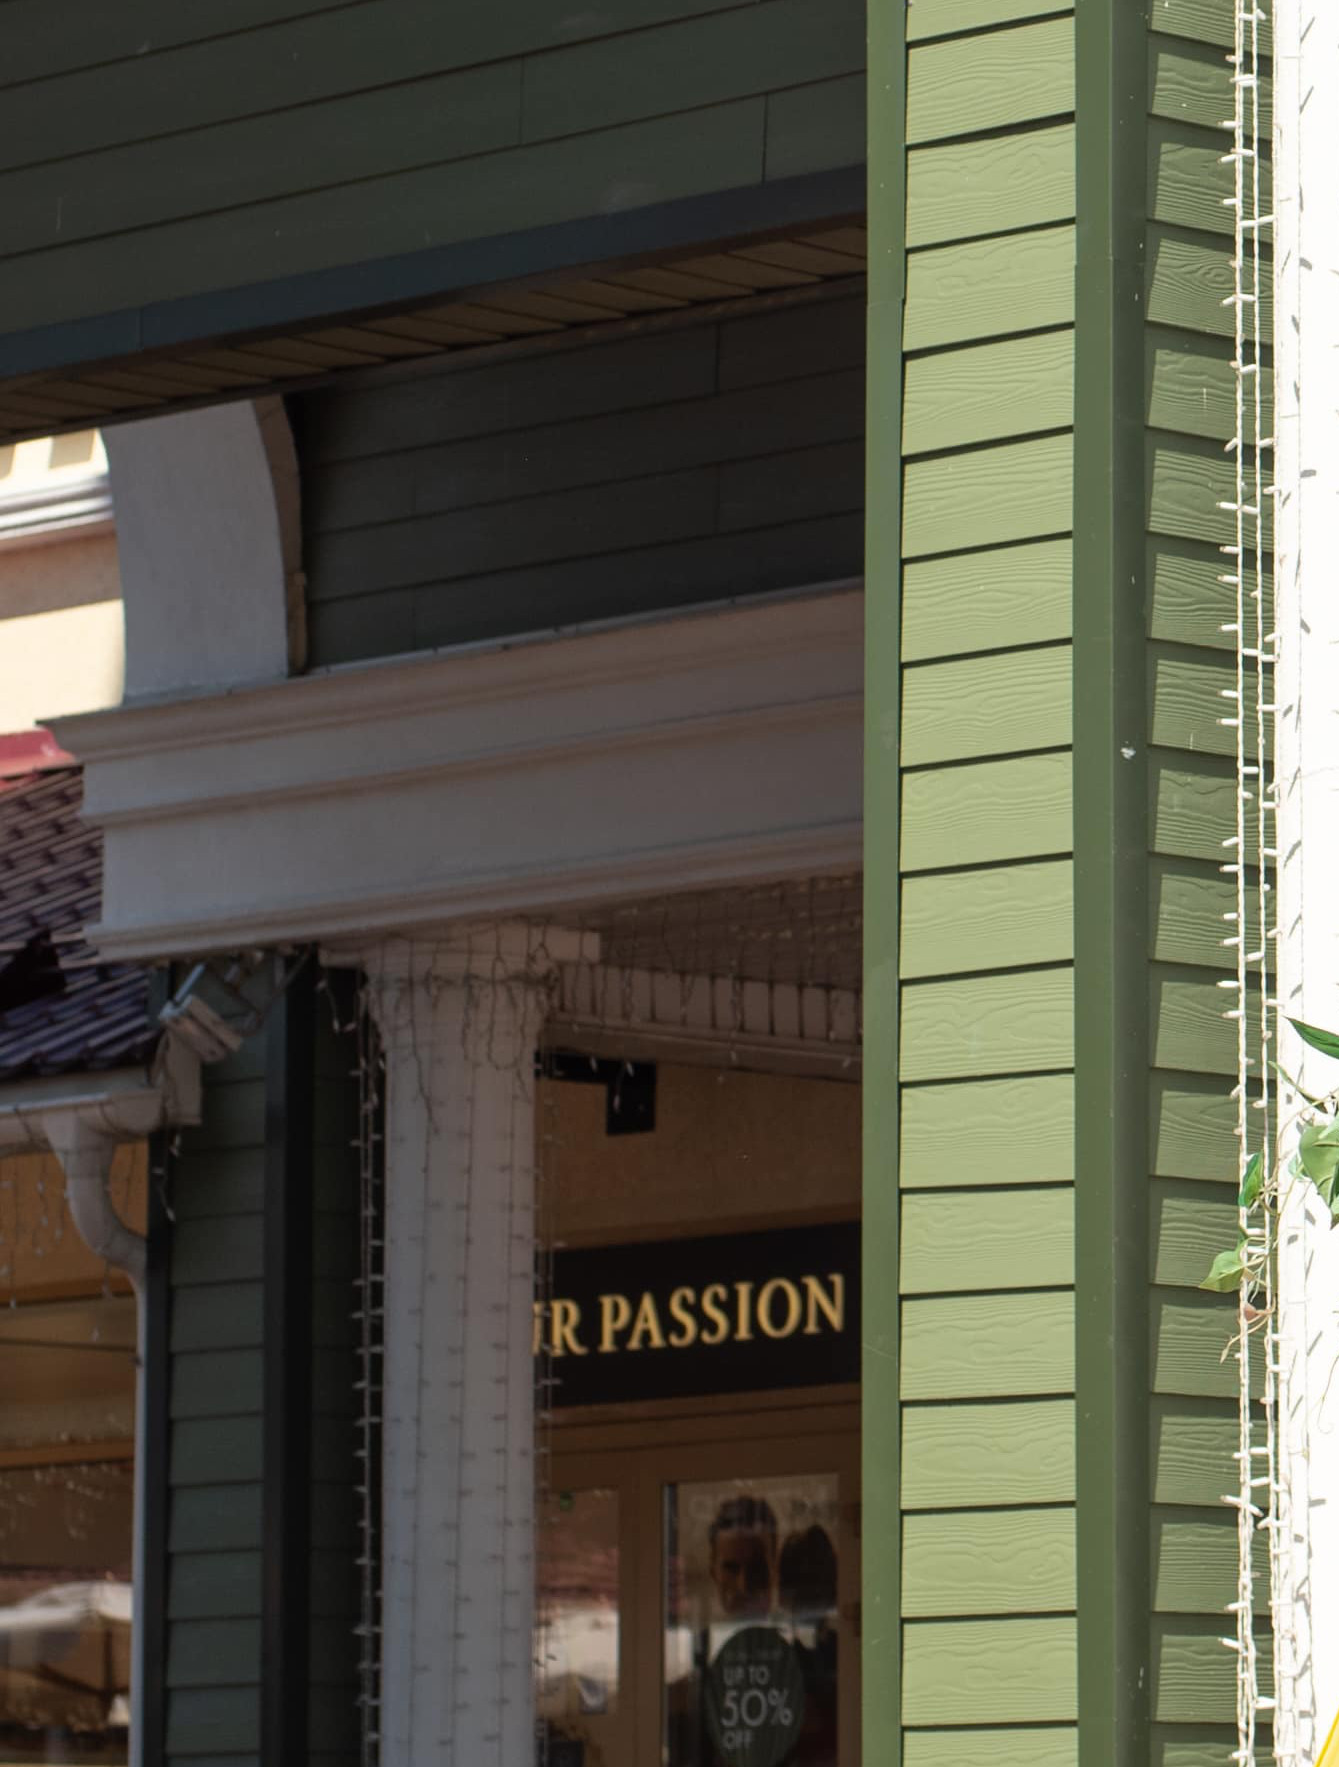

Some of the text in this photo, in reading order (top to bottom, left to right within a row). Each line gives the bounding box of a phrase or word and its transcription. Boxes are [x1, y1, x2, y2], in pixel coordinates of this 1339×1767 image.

[598, 1272, 845, 1353] PASSION
[723, 1664, 770, 1686] UP TO
[720, 1687, 793, 1728] 50%
